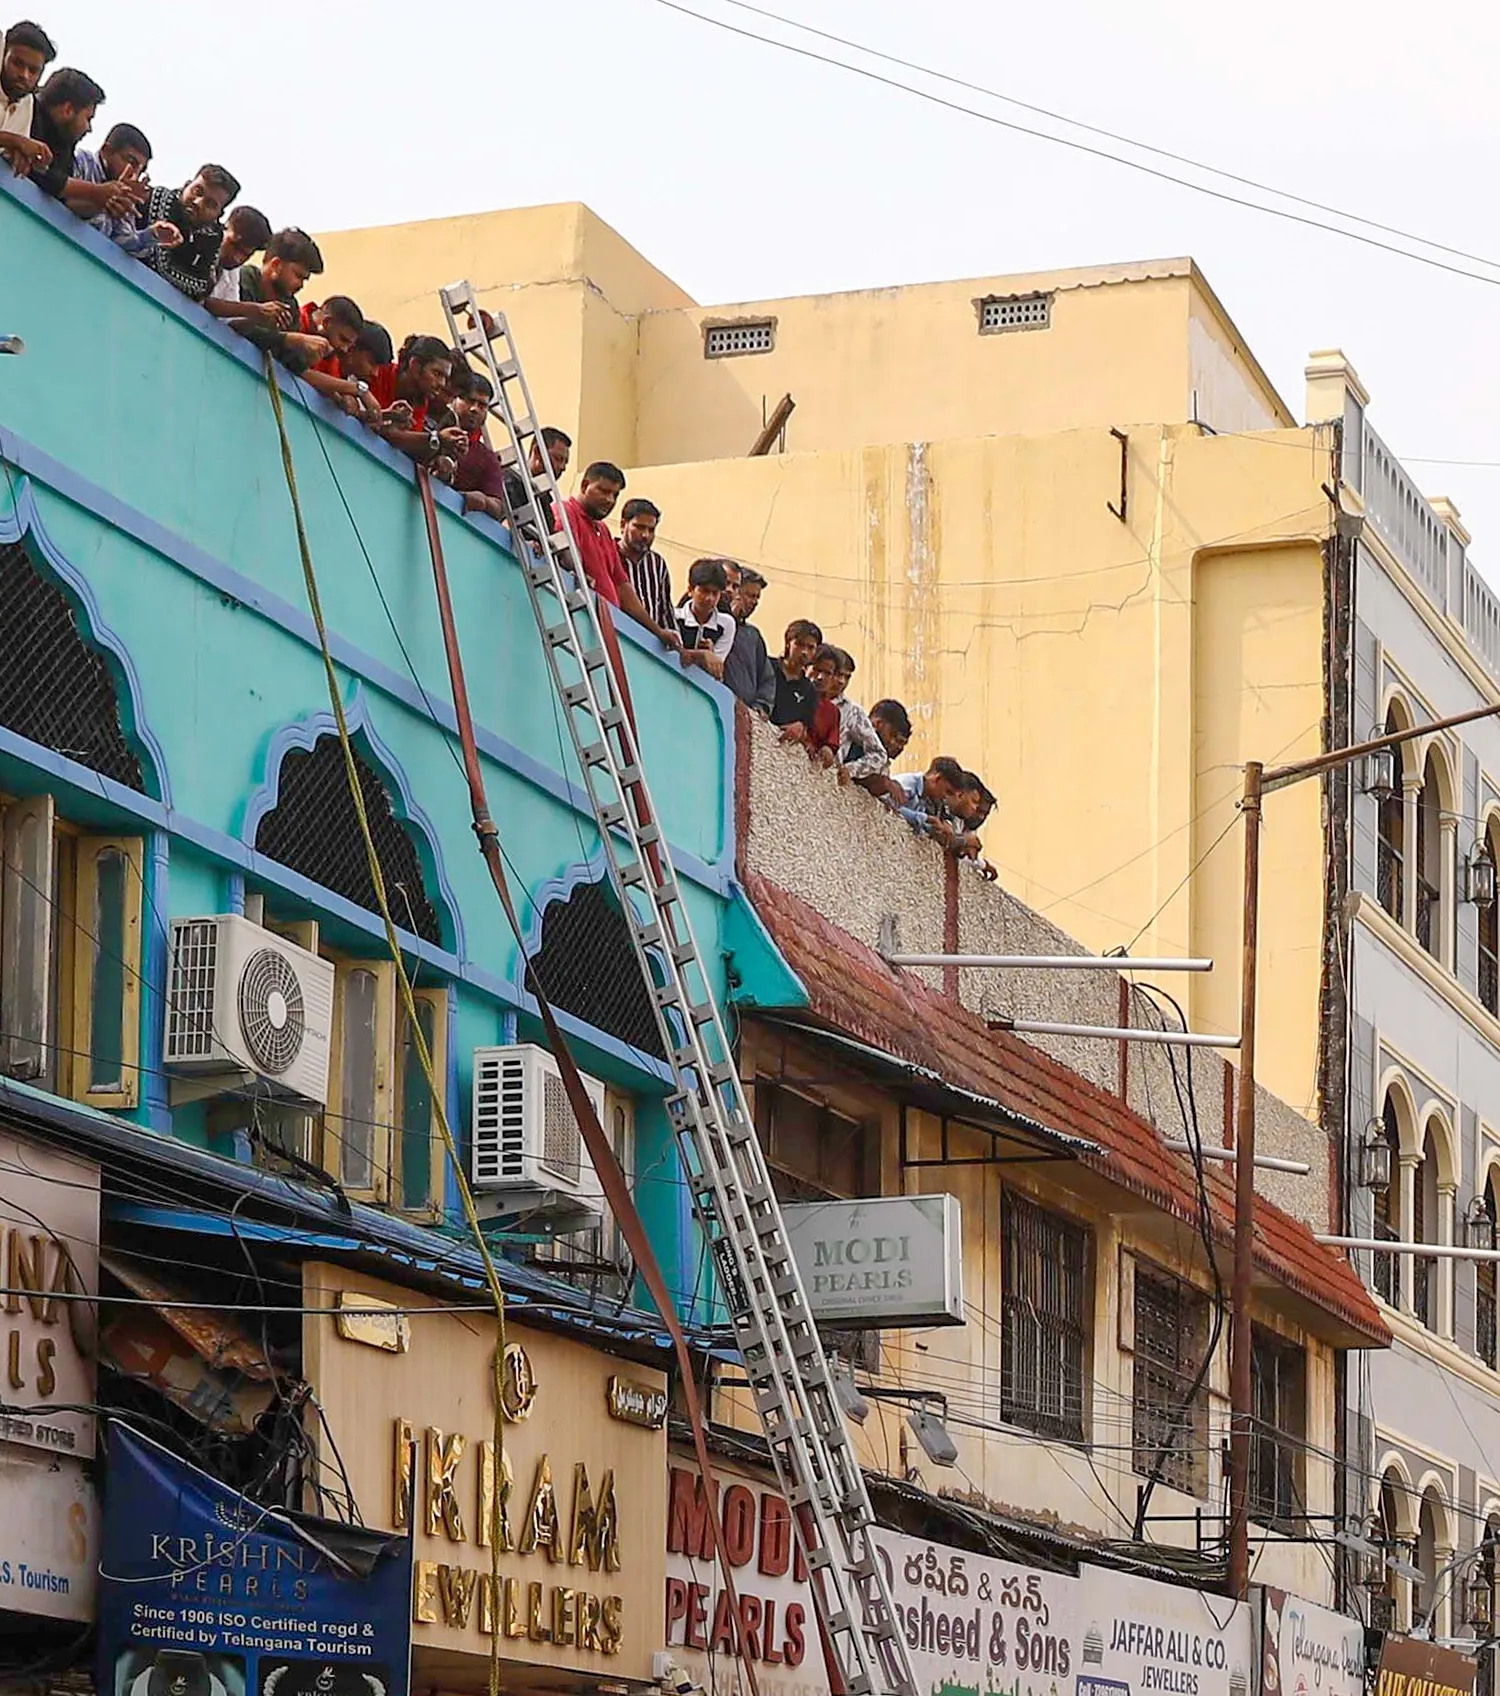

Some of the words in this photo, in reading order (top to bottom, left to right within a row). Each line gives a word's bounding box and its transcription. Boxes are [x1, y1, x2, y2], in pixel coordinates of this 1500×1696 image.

[814, 1236, 910, 1268] MODI
[813, 1269, 913, 1294] PEARLS
[36, 1424, 75, 1449] STORE
[394, 1418, 621, 1572] IKRAM
[18, 1563, 69, 1594] Tourism
[172, 1569, 309, 1600] PEARLS
[977, 1572, 993, 1602] &
[134, 1605, 175, 1621] Since
[180, 1610, 214, 1625] 1906
[219, 1613, 246, 1629] ISO
[251, 1616, 317, 1633] Certified
[322, 1621, 359, 1638] regd
[363, 1624, 374, 1637] &
[666, 1577, 806, 1665] PEARLS
[131, 1623, 195, 1643] Certified
[199, 1629, 218, 1646] by
[223, 1631, 302, 1652] Telangana
[307, 1638, 372, 1656] Tourism
[989, 1611, 1007, 1667] &
[1015, 1616, 1071, 1678] Sons
[1109, 1618, 1164, 1660] JAFFAR
[1166, 1630, 1188, 1664] ALI
[1192, 1635, 1203, 1667] &
[1205, 1638, 1228, 1671] CO.
[1141, 1665, 1199, 1696] JEWELLERS
